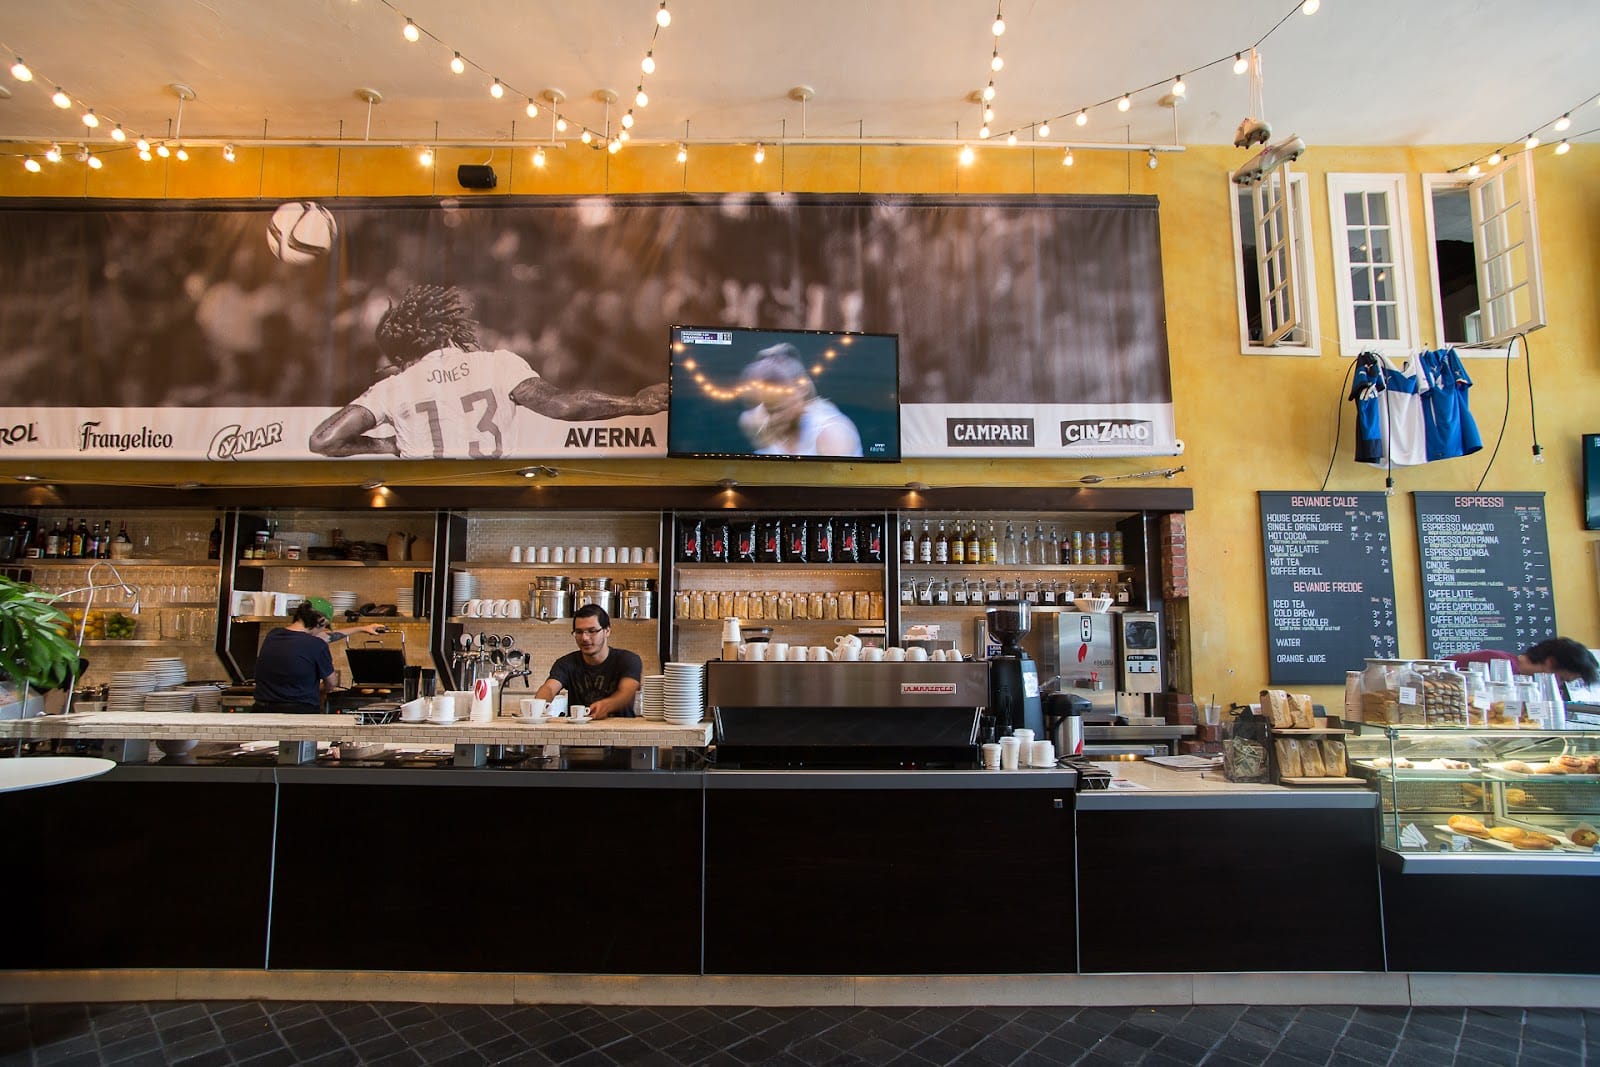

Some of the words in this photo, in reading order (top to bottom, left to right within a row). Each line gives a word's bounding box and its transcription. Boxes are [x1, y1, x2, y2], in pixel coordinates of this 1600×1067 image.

[79, 421, 174, 452] Frangelico
[954, 424, 1029, 441] CAMPARI
[1065, 422, 1149, 443] CINZANO
[564, 427, 656, 448] AVERNA
[206, 423, 283, 462] CYNAR
[1291, 496, 1331, 507] BEVANDE
[1333, 496, 1358, 507] CALDE
[1455, 497, 1504, 507] ESPRESSI
[1267, 514, 1290, 522] HOUSE
[1292, 514, 1320, 522] COFFEE
[1421, 514, 1460, 522] ESPRESSO
[1268, 523, 1292, 531] SINGLE
[1295, 523, 1317, 531] ORIGIN
[1319, 523, 1343, 531] COFFEE
[1422, 523, 1460, 531] ESPRESSO
[1269, 532, 1282, 540] HOT
[1284, 532, 1307, 540] COCOA
[1423, 536, 1461, 544] ESPRESSO
[1462, 536, 1476, 544] CON
[1477, 536, 1499, 544] PANNA
[1270, 545, 1284, 553] CHAI
[1287, 545, 1298, 553] TEA
[1299, 545, 1319, 553] LATTE
[1425, 548, 1462, 556] ESPRESSO
[1463, 548, 1489, 556] BOMBA
[1271, 558, 1284, 566] HOT
[1287, 558, 1300, 566] TEA
[1426, 561, 1450, 569] CINQUE
[1271, 567, 1297, 575] COFFEE
[1299, 567, 1322, 575] REFILL
[1294, 582, 1330, 592] BEVANDE
[1428, 590, 1451, 598] CAFFE
[1451, 590, 1473, 598] LATTE
[1274, 600, 1289, 608] ICED
[1292, 600, 1305, 608] TEA
[1430, 603, 1452, 611] CAFFE
[1453, 603, 1494, 611] CAPPUCCINO
[1274, 609, 1292, 617] COLD
[1294, 609, 1315, 617] BREW
[1275, 618, 1300, 626] COFFEE
[1303, 618, 1329, 626] COOLER
[1431, 616, 1452, 624] CAFFE
[1454, 616, 1478, 624] MOCHA
[1432, 629, 1454, 637] CAFFE
[1455, 629, 1488, 637] VIENNESE
[1276, 638, 1301, 646] WATER
[1433, 642, 1455, 650] CAFFE
[1457, 642, 1480, 650] BREVE
